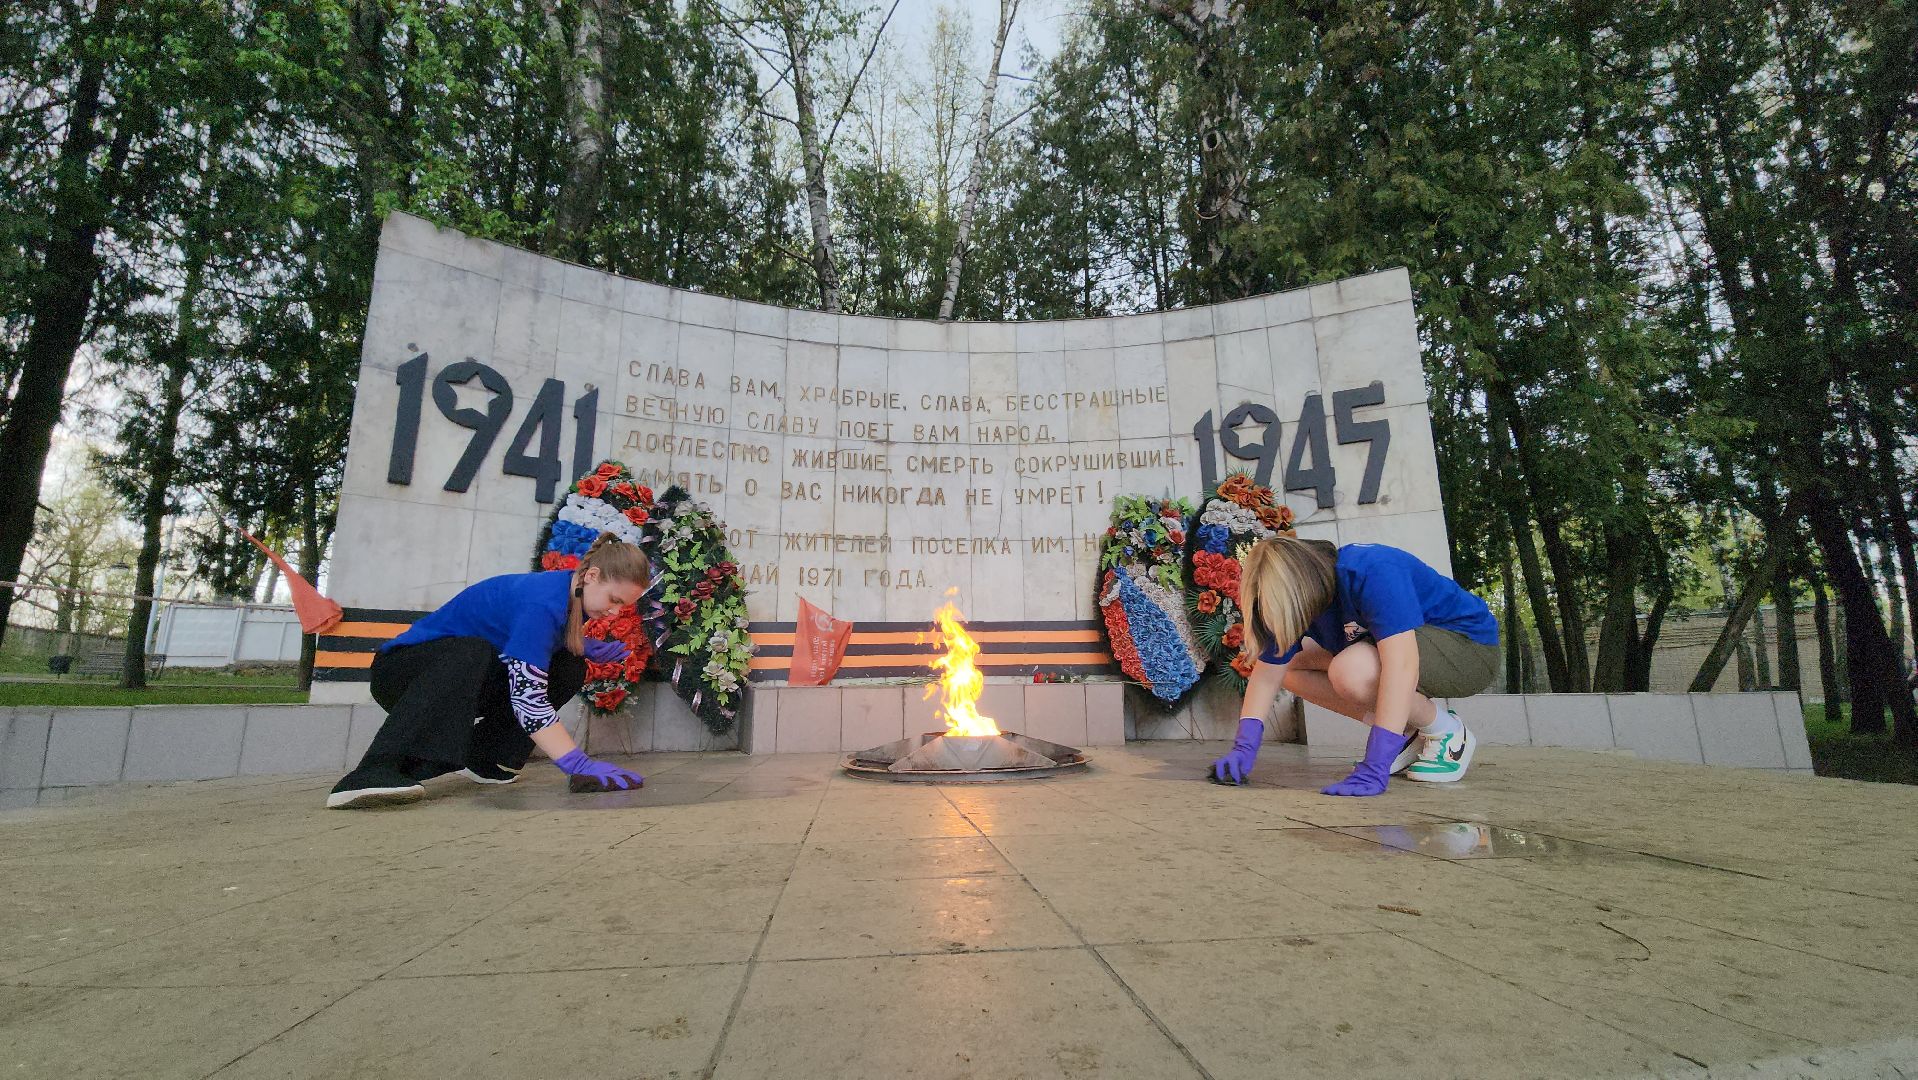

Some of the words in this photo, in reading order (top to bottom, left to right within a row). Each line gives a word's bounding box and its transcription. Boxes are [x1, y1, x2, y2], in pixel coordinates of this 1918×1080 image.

[628, 360, 705, 389] СЛАВА
[730, 375, 783, 402] ВАМ,
[800, 385, 907, 411] ХРАБРЫЕ,
[921, 393, 991, 413] СЛАВА,
[1006, 385, 1166, 412] БЕССТРАШНЫЕ
[387, 352, 599, 503] 1941
[625, 395, 725, 424] ВЕЧНУЮ
[747, 411, 819, 435] СЛАВУ
[839, 420, 894, 441] ПОЕТ
[913, 424, 960, 442] ВАМ
[623, 430, 770, 464] ДОБЛЕСТНО
[906, 455, 994, 475] СМЕРТЬ
[1193, 384, 1391, 508] 1945
[628, 466, 723, 494] АМЯТЬ
[744, 478, 758, 497] О
[781, 480, 822, 501] ВАС
[842, 484, 946, 506] НИКОГДА
[965, 488, 994, 506] НЕ
[729, 528, 758, 549] ОТ
[784, 532, 893, 554] ЖИТЕЛЕЙ
[912, 536, 1012, 555] ПОСЕЛКА
[1031, 535, 1070, 554] ИМ.
[799, 566, 842, 587] 1971
